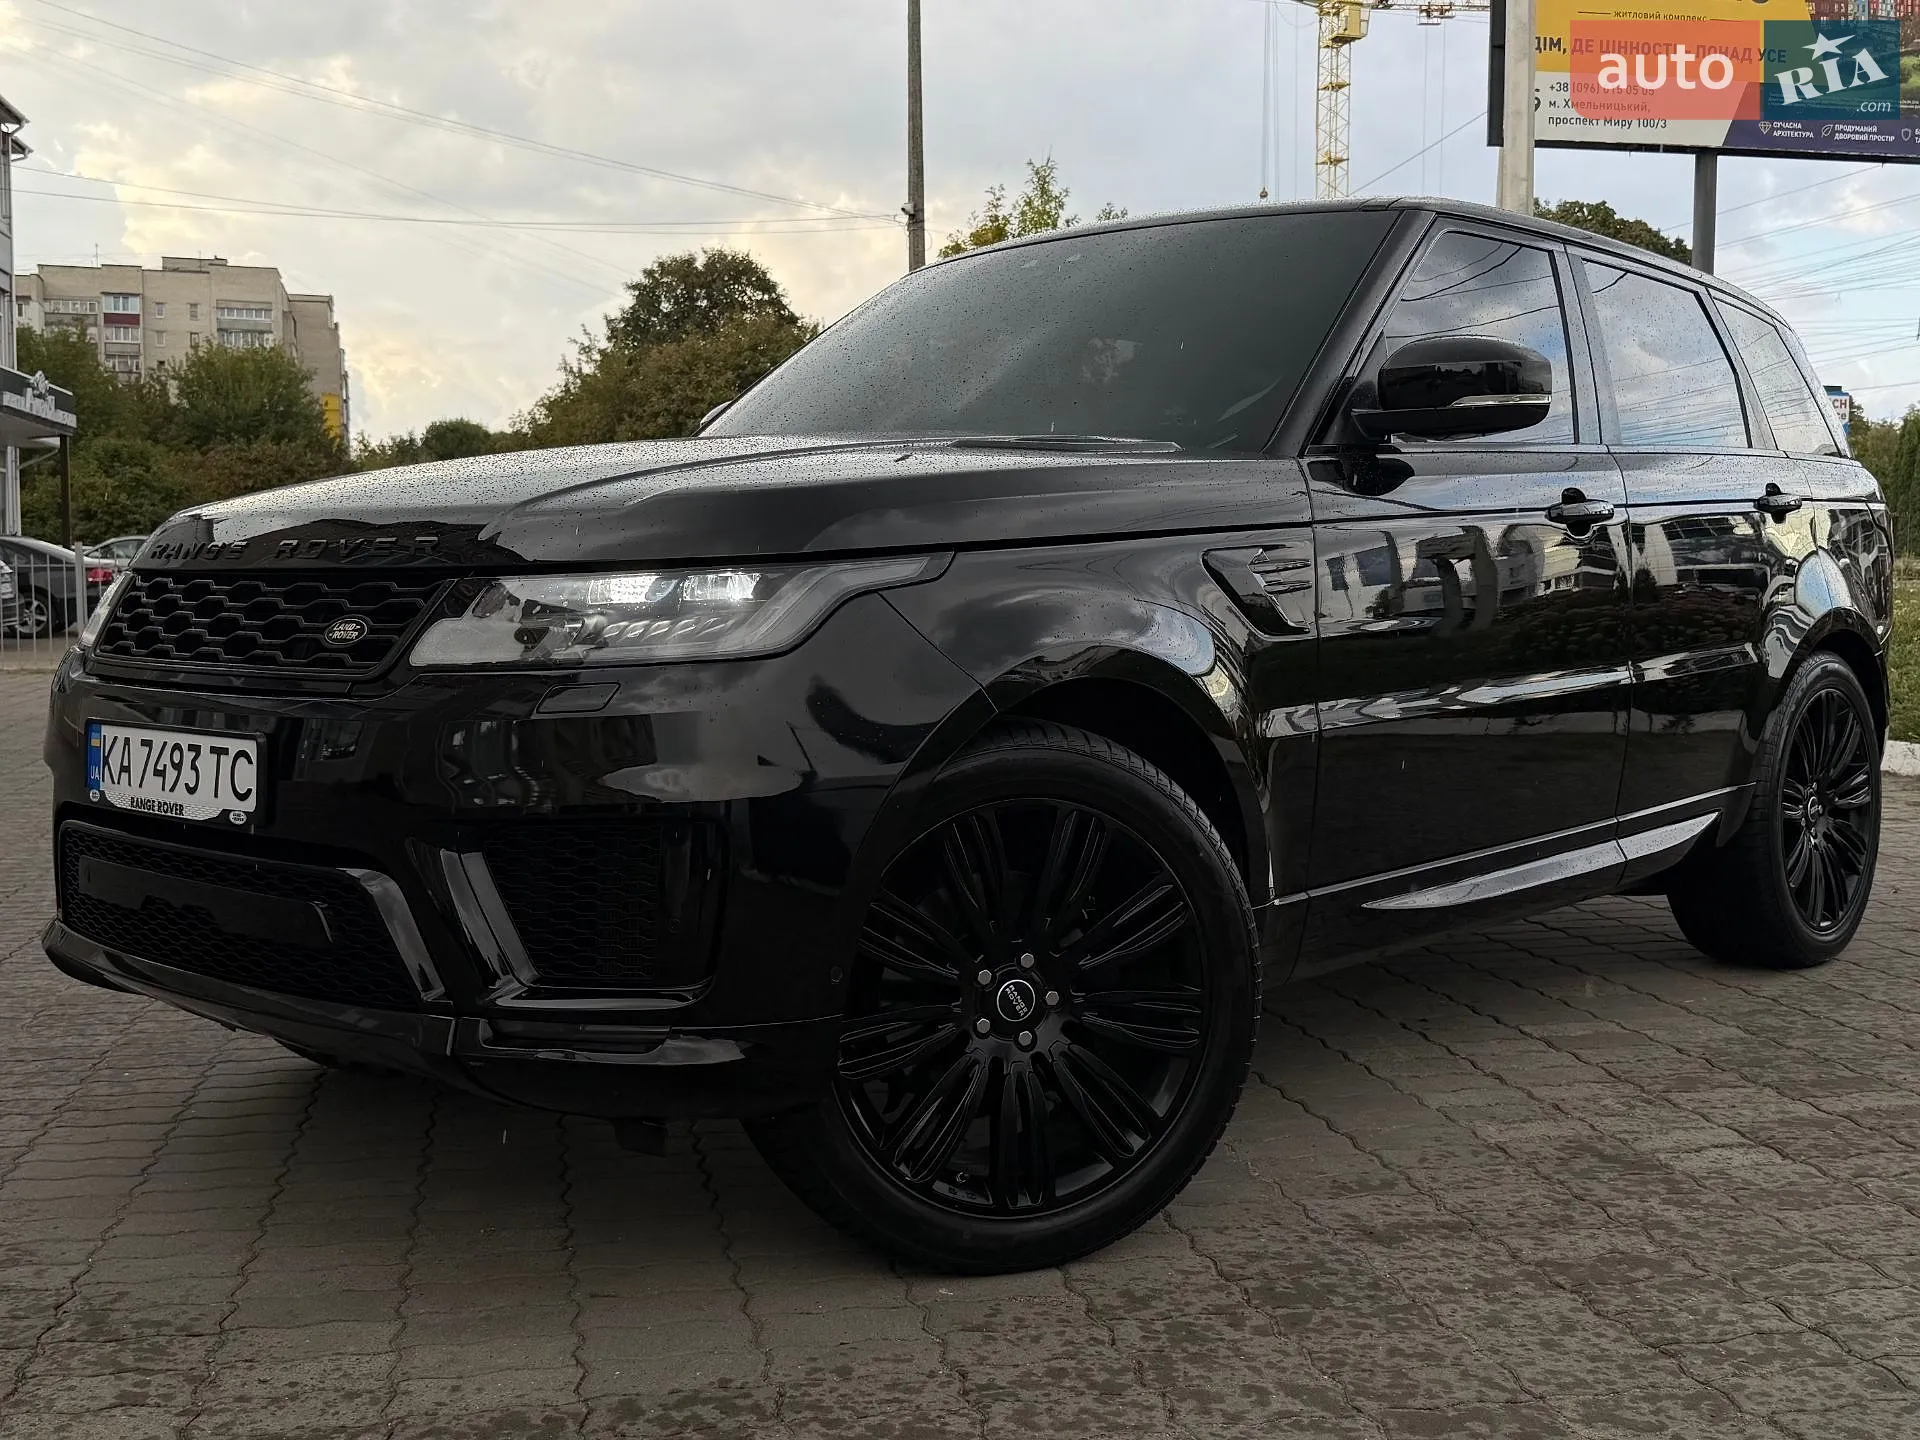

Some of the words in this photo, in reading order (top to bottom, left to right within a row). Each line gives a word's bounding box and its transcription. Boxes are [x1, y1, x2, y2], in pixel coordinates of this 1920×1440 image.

[1613, 10, 1661, 20] житловий
[1663, 14, 1707, 22] комплекс
[1571, 38, 1594, 55] ДЕ
[1758, 48, 1787, 63] УСЕ
[1549, 82, 1569, 92] +38
[1572, 82, 1600, 94] (096)
[1548, 100, 1560, 109] м.
[1563, 99, 1651, 113] Хмельницький,
[1548, 116, 1600, 127] проспект
[1603, 116, 1633, 129] Миру
[1637, 118, 1667, 129] 100/3
[150, 540, 249, 560] RANGE
[274, 535, 440, 559] ROVER
[332, 630, 359, 640] ROVER
[90, 765, 100, 780] UA
[130, 796, 157, 813] RANGE
[157, 802, 185, 816] ROVER
